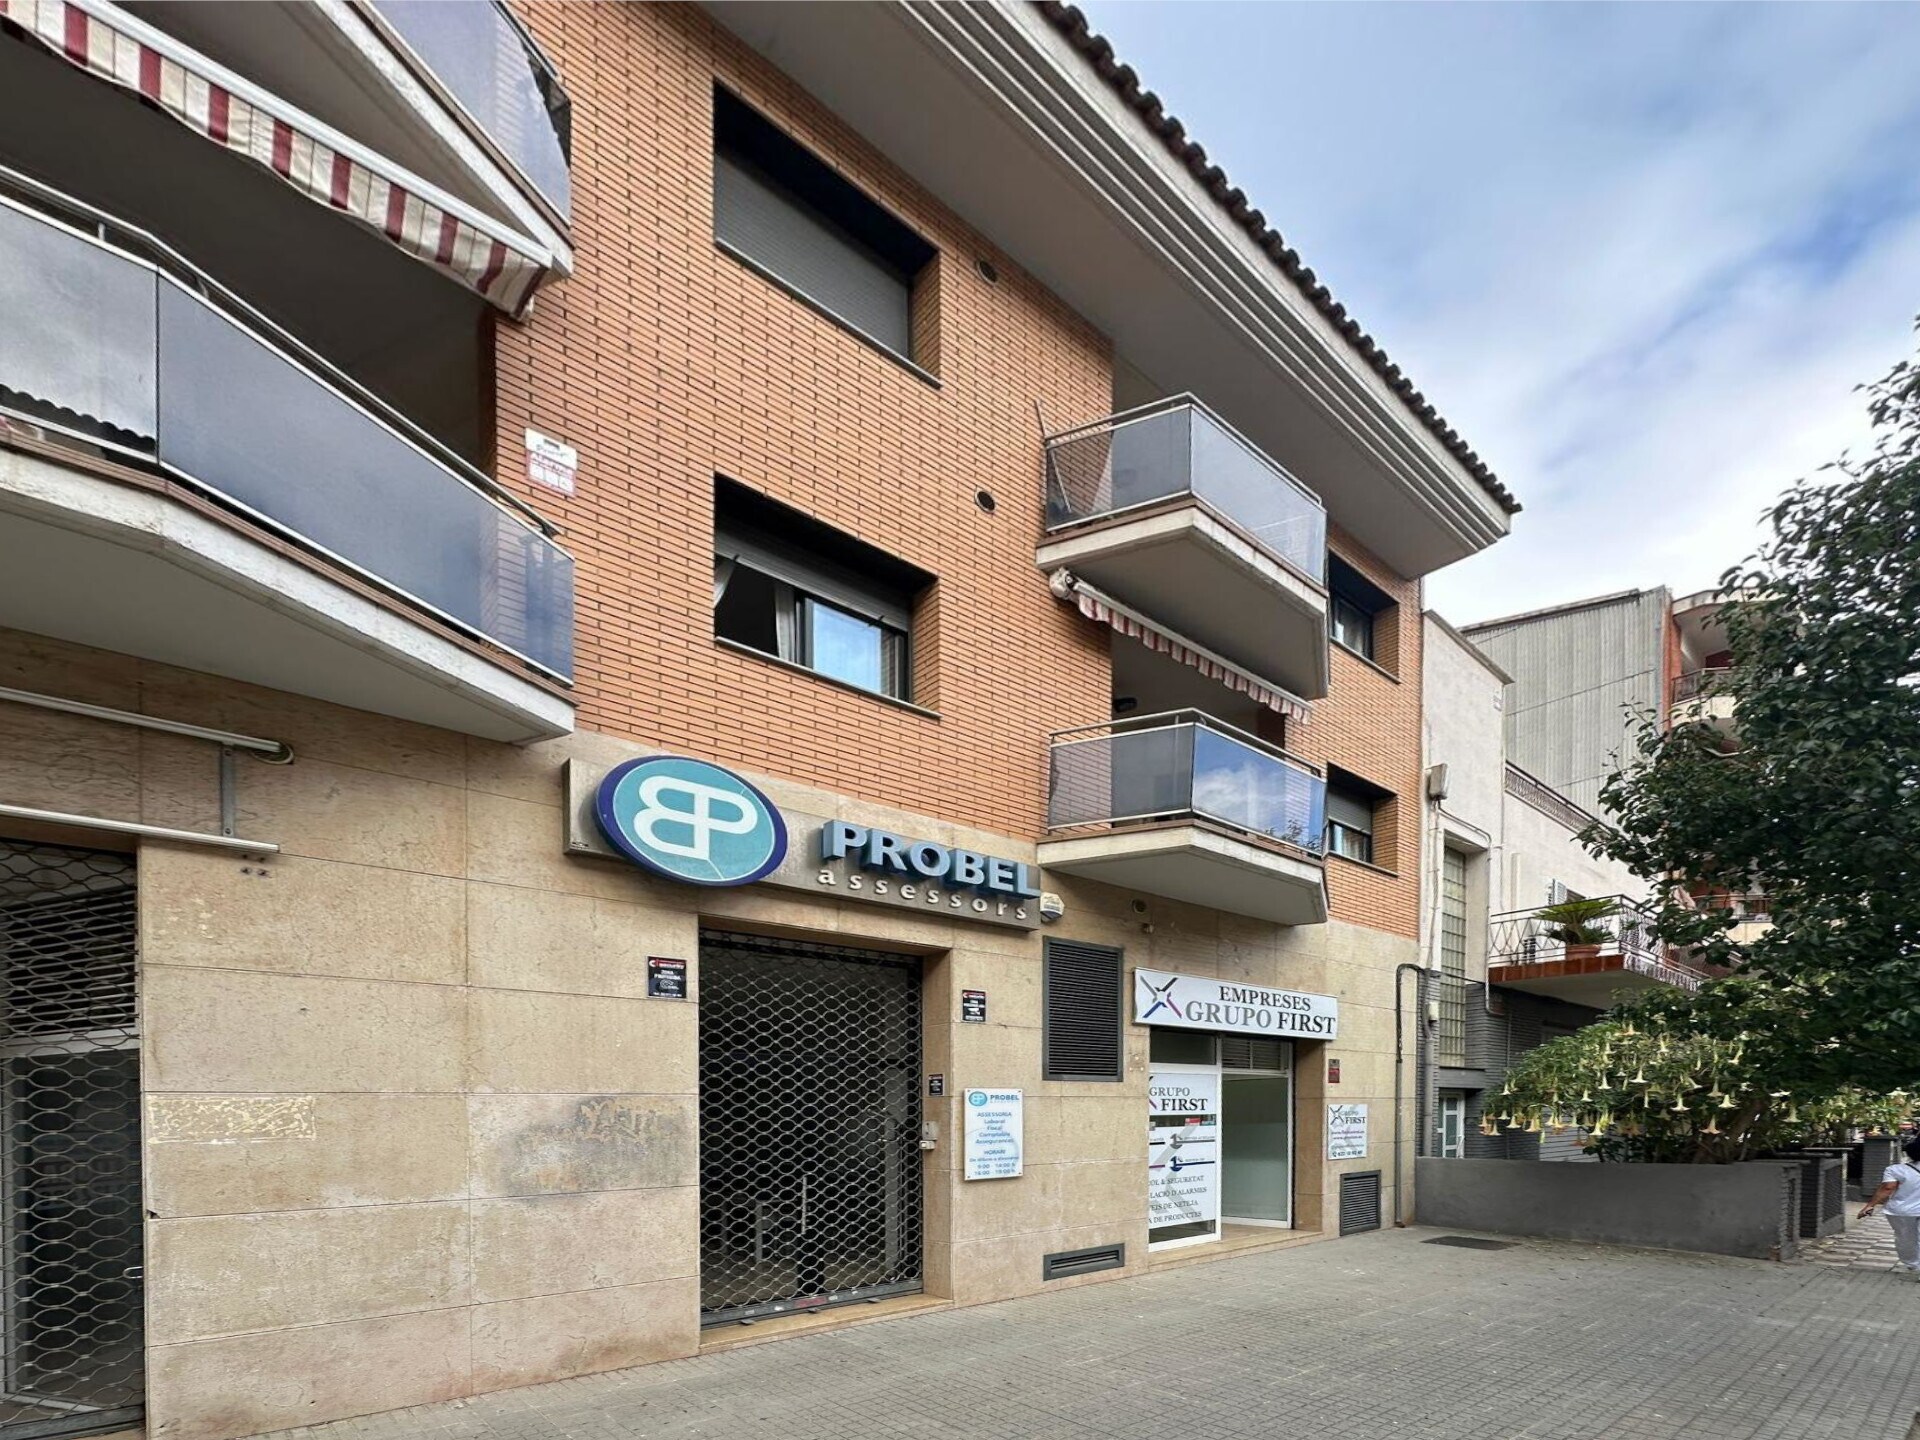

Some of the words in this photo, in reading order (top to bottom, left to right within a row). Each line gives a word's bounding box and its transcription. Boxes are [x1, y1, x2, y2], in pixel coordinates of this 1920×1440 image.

[823, 820, 1041, 899] PROBEL
[817, 869, 1027, 920] assessors
[1219, 985, 1311, 1012] EMPRESES
[1185, 1000, 1272, 1029] GRUPO
[1277, 1011, 1336, 1034] FIRST
[1149, 1087, 1190, 1097] GRUPO
[1161, 1098, 1208, 1111] FIRST
[1345, 1116, 1366, 1125] FIRST
[1167, 1175, 1204, 1185] SEGURETAT
